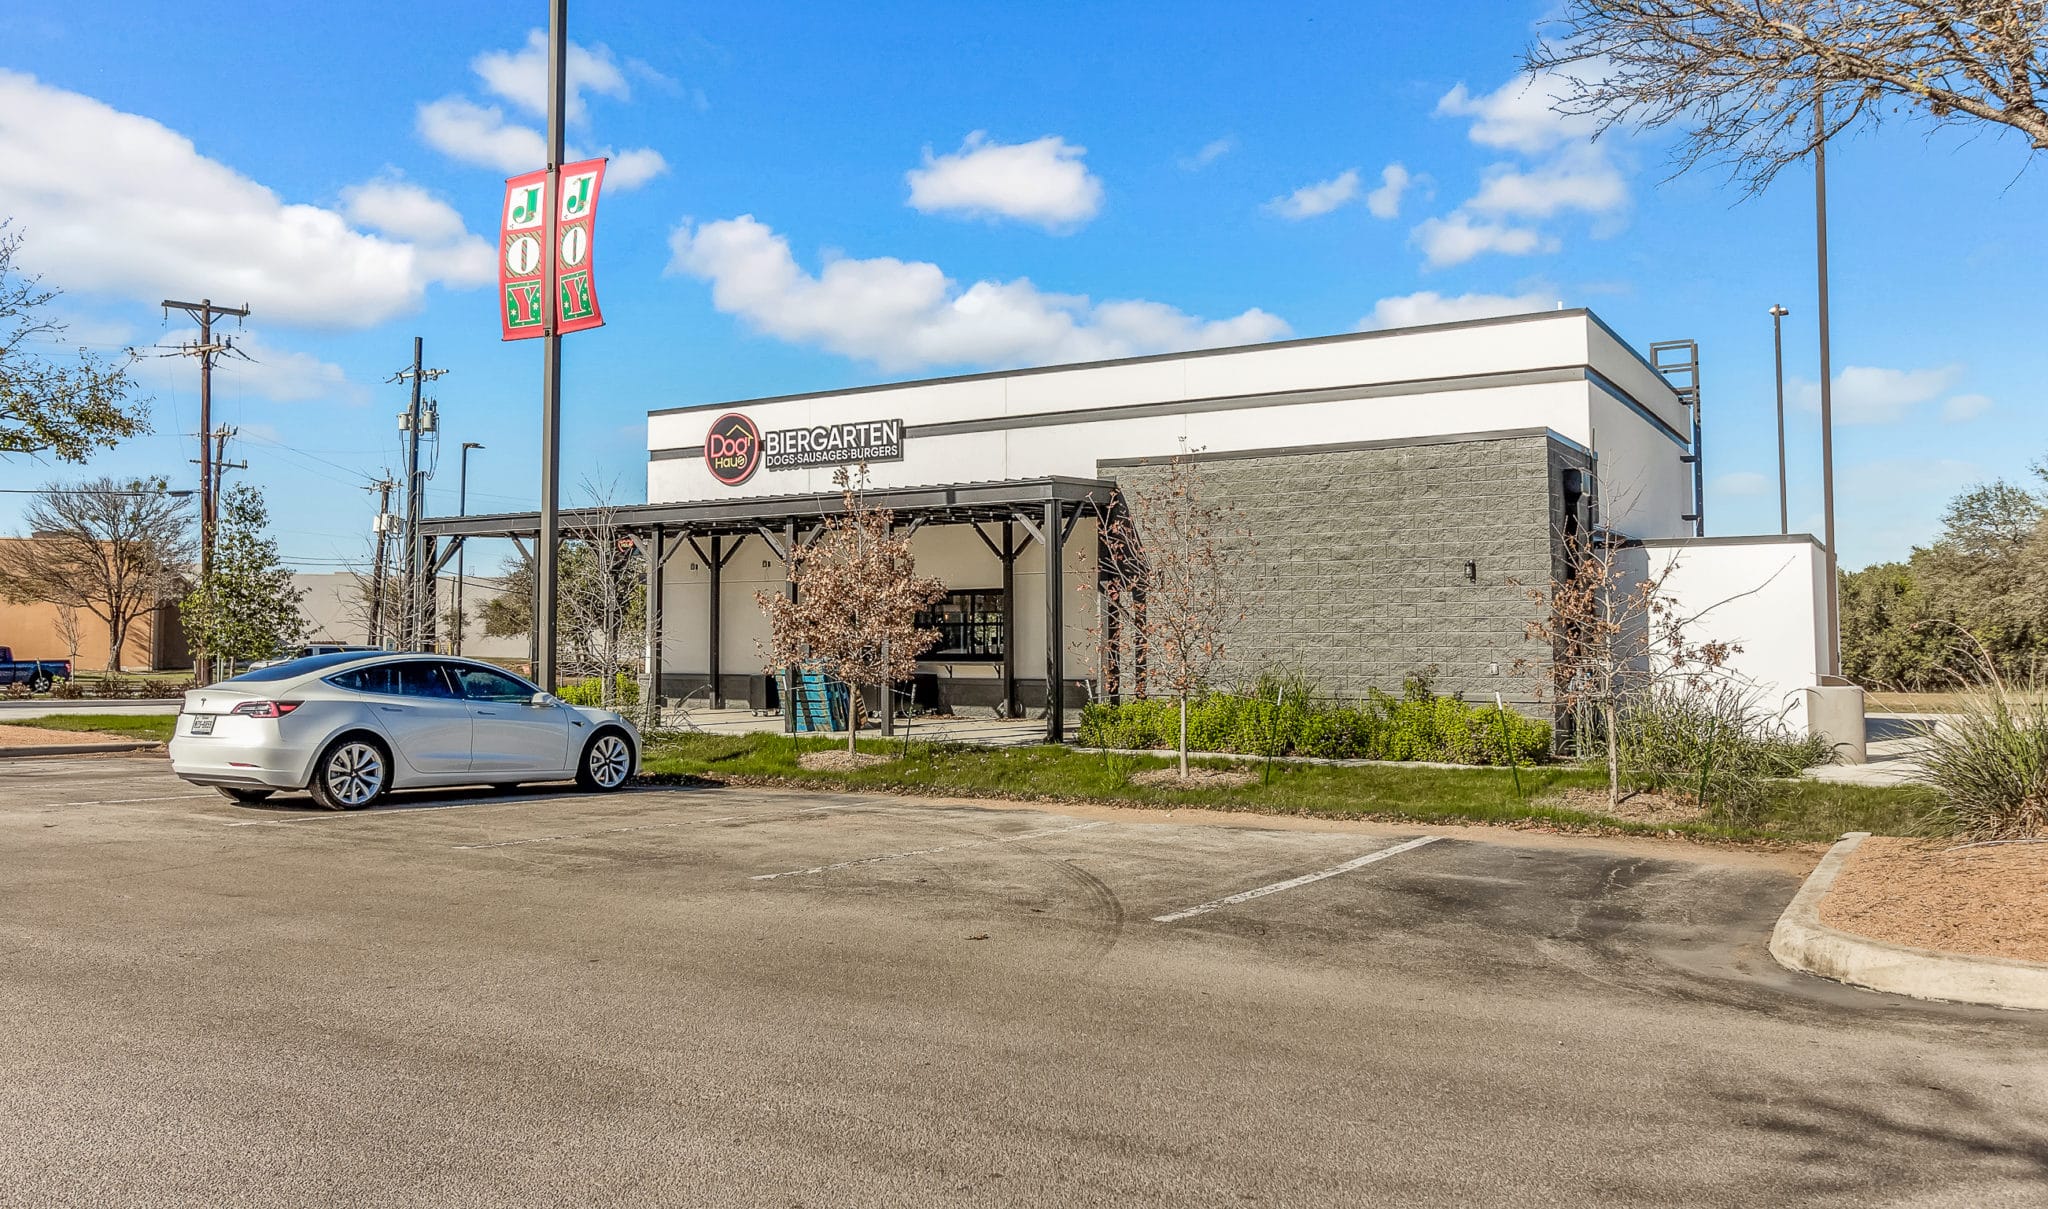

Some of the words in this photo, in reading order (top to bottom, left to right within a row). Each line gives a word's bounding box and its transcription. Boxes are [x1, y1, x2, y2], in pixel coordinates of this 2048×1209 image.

[711, 434, 748, 468] Dog
[766, 421, 897, 455] BIERGARTEN
[715, 456, 745, 469] Haus
